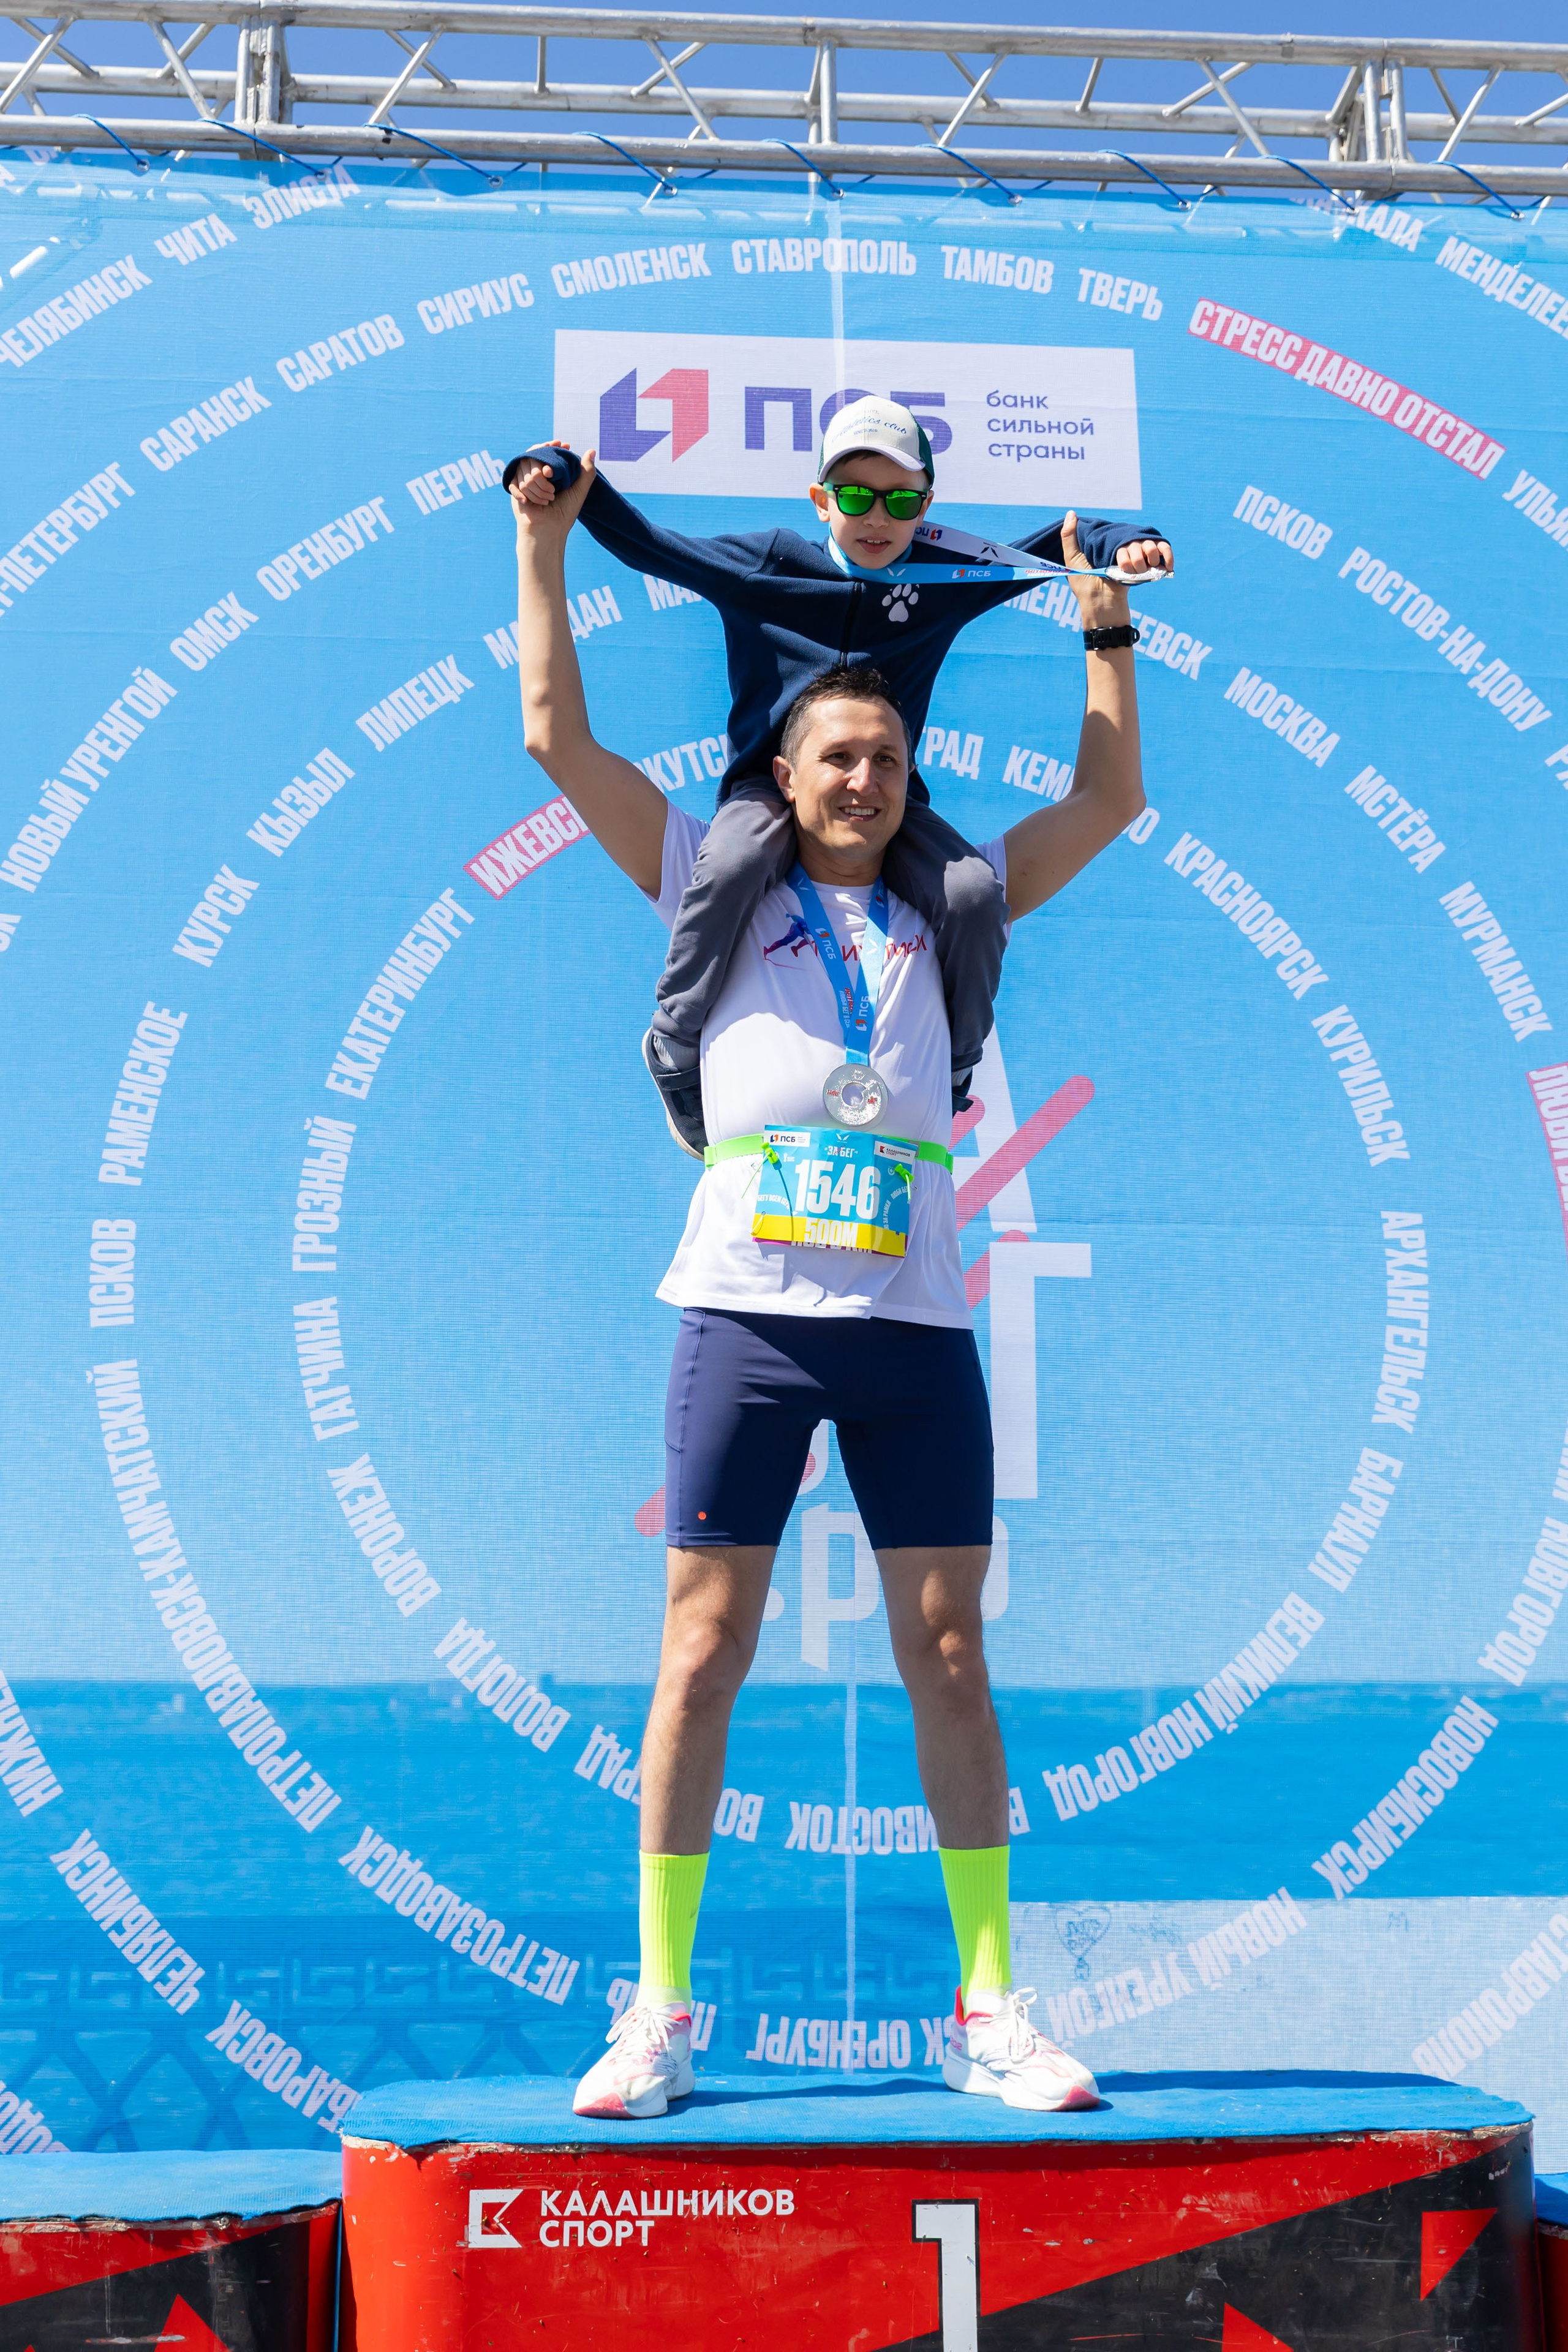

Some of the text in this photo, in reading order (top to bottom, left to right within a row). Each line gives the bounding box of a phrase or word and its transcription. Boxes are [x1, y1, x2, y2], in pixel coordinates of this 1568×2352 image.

[154, 214, 237, 265] ЧИТА
[245, 165, 360, 229] ЭЛИСТА
[417, 273, 535, 334] СИРИУС
[551, 243, 712, 298] СМОЛЕНСК
[731, 238, 916, 276] СТАВРОПОЛЬ
[941, 245, 1055, 294] ТАМБОВ
[1078, 268, 1164, 321] ТВЕРЬ
[1435, 236, 1568, 340] МЕНДЕЛЕЕ
[0, 255, 153, 368] ЧЕЛЯБИНСК
[276, 314, 405, 393] САРАТОВ
[140, 376, 272, 471] САРАНСК
[884, 420, 907, 434] club
[986, 390, 1049, 409] банк
[987, 417, 1095, 436] сильной
[1189, 300, 1506, 479] СТРЕСС ДАВНО ОТСТАЛ
[406, 450, 505, 516] ПЕРМЬ
[988, 442, 1085, 462] страны
[0, 462, 135, 616] -ПЕТЕРБУРГ
[256, 496, 395, 601] ОРЕНБУРГ
[1232, 486, 1333, 559] ПСКОВ
[1502, 469, 1568, 552] УЛЬЯ
[170, 591, 259, 671] ОМСК
[1338, 546, 1553, 731] РОСТОВ-НА-ДОНУ
[356, 654, 475, 752] ЛИПЕЦК
[1224, 667, 1340, 768] МОСКВА
[0, 666, 178, 893] НОВЫЙ УРЕНГОЙ
[246, 747, 356, 858] КЫЗЫЛ
[1344, 764, 1446, 874] МСТЁРА
[172, 864, 260, 968] КУРСК
[822, 940, 837, 960] ПСБ
[1164, 832, 1329, 1001] КРАСНОЯРСК
[1439, 881, 1553, 1042] МУРМАНСК
[325, 888, 475, 1100] ЕКАТЕРИНБУРГ
[859, 996, 870, 1017] ПСБ
[99, 1001, 187, 1186] РАМЕНСКОЕ
[1311, 1004, 1410, 1167] КУРИЛЬСК
[292, 1115, 357, 1271] ГРОЗНЫЙ
[794, 1159, 881, 1219] 1546
[804, 1217, 859, 1247] 500М
[89, 1218, 137, 1327] ПСКОВ
[1371, 1210, 1429, 1434] АРХАНГЕЛЬСК
[293, 1296, 360, 1441] ГАТЧИНА
[326, 1452, 442, 1618] ВОРОНЕЖ
[1307, 1447, 1403, 1593] БАРНАУЛ
[86, 1359, 342, 1833] ПЕТРОПАВЛОВСК-КАМЧАТСКИЙ
[1477, 1516, 1568, 1687] НОВГОРОД
[433, 1617, 571, 1752] ВОЛОГДА
[1042, 1591, 1326, 1822] ВЕЛИКИЙ НОВГОРОД
[1311, 1695, 1499, 1900] НОВОСИБИРСК
[50, 1828, 205, 2015] ЧЕЛЯБИНСК
[339, 1825, 580, 2005] ПЕТРОЗАВОДСК
[1186, 1887, 1308, 1992] НОВЫЙ
[746, 2013, 911, 2069] ОРЕНБУРГ
[1044, 1951, 1194, 2048] УРЕНГОЙ
[205, 1999, 361, 2133] БАРОВСК
[540, 2220, 655, 2248] СПОРТ
[541, 2189, 795, 2217] КАЛАШНИКОВ
[912, 2199, 979, 2352] 1
